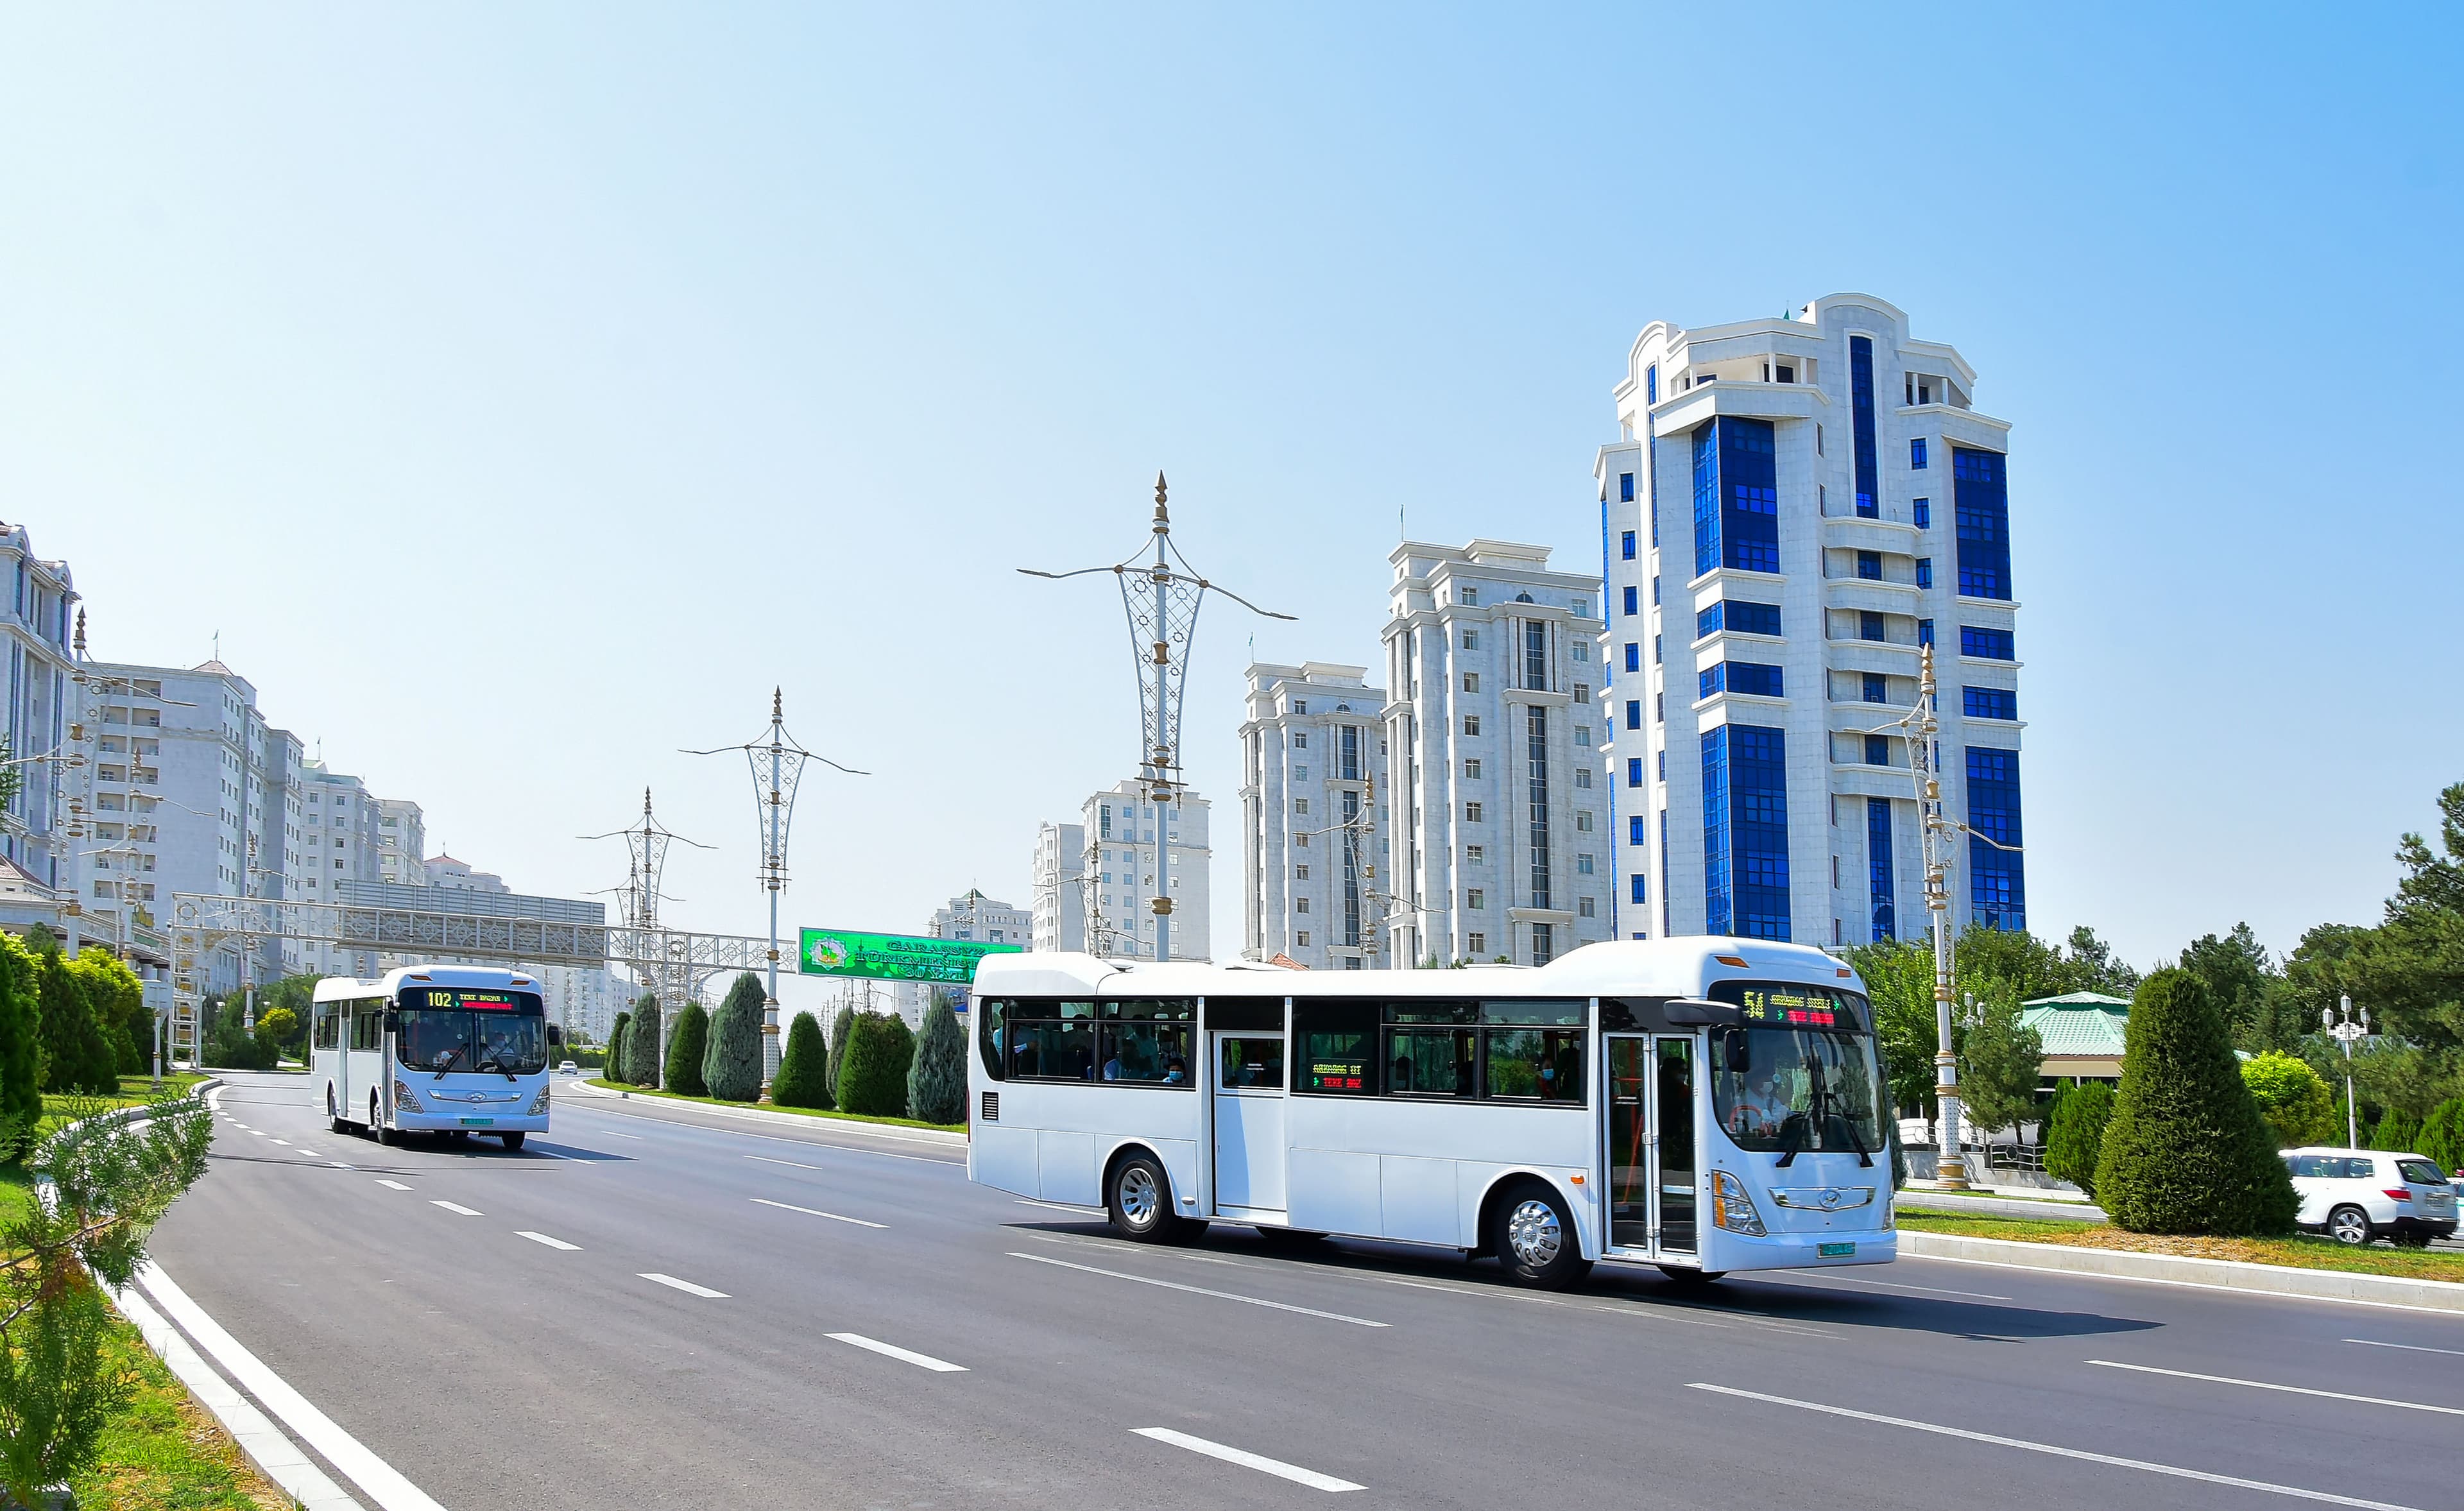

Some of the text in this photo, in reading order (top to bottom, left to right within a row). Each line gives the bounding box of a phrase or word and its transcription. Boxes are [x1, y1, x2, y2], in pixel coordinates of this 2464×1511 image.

[855, 950, 978, 969] TÜRKMENIST
[904, 968, 925, 978] 30
[428, 992, 452, 1007] 102
